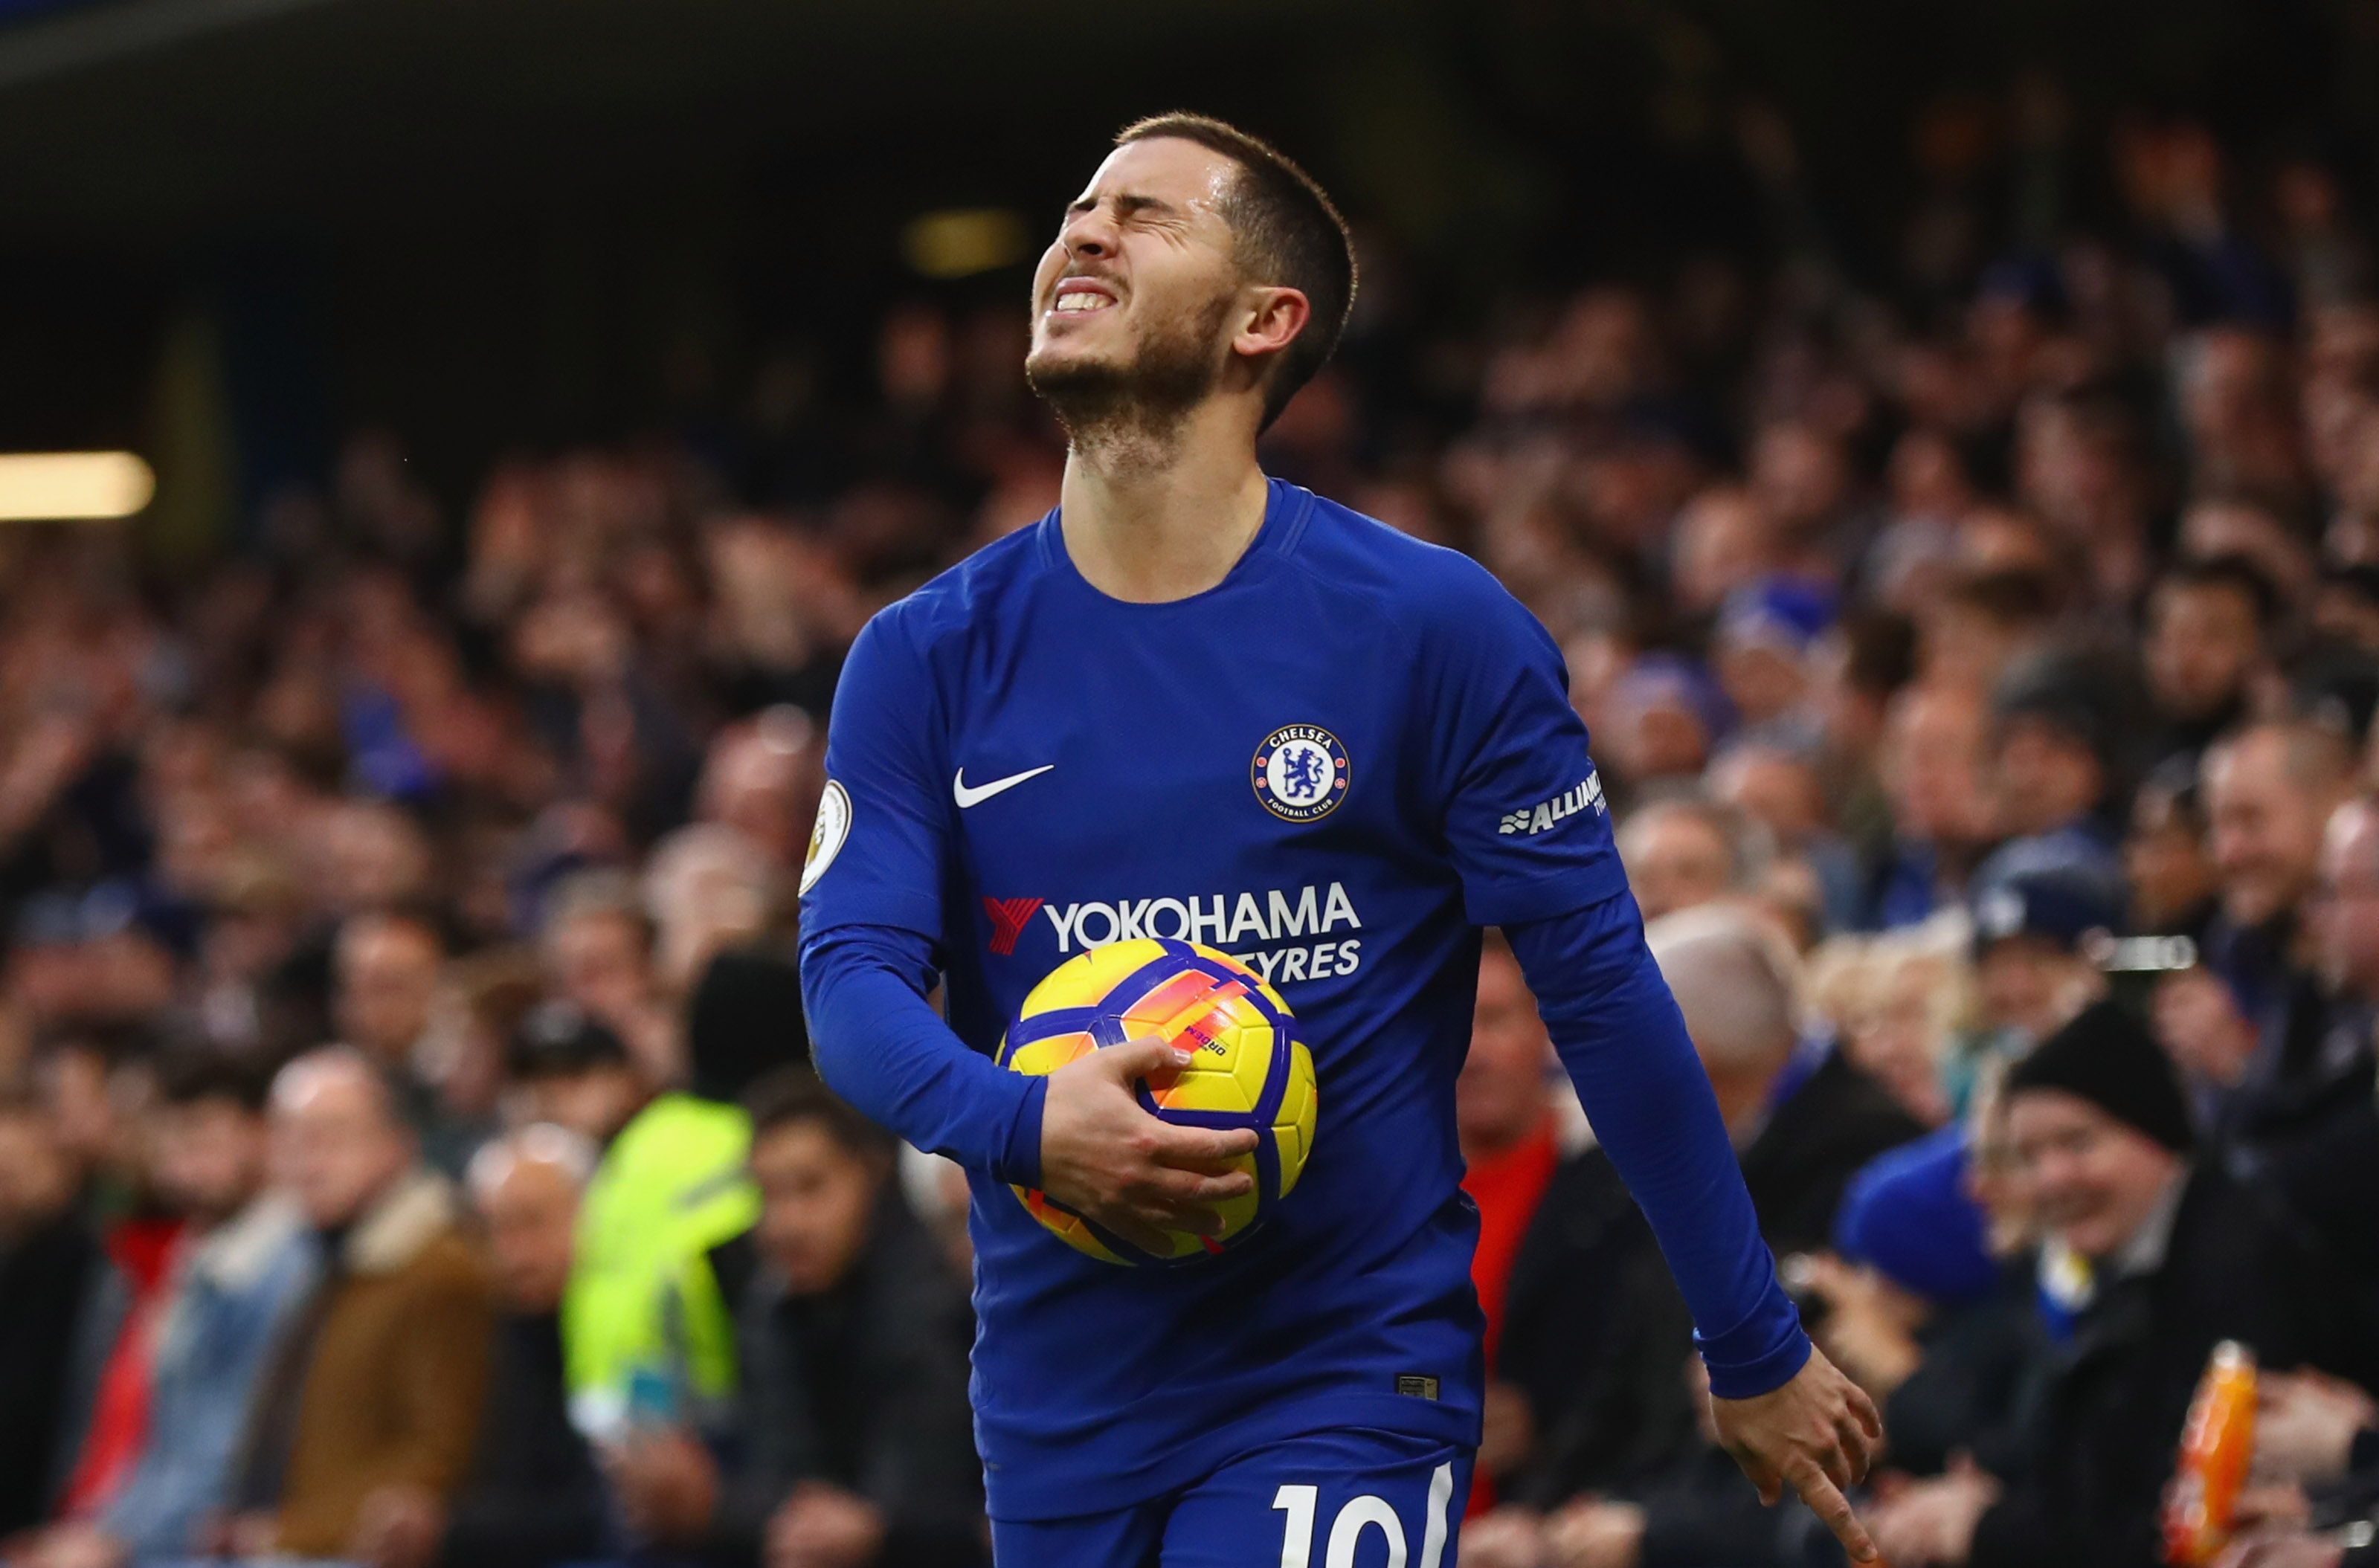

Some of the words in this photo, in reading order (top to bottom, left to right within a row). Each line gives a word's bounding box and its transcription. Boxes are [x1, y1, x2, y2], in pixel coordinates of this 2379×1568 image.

[1269, 728, 1333, 749] CHELSEA
[1267, 798, 1310, 817] FOOTBALL
[1312, 798, 1333, 815] CLUB
[1043, 882, 1362, 952] YOKOHAMA
[1184, 1025, 1226, 1056] ORDEM
[1272, 1485, 1408, 1568] 10
